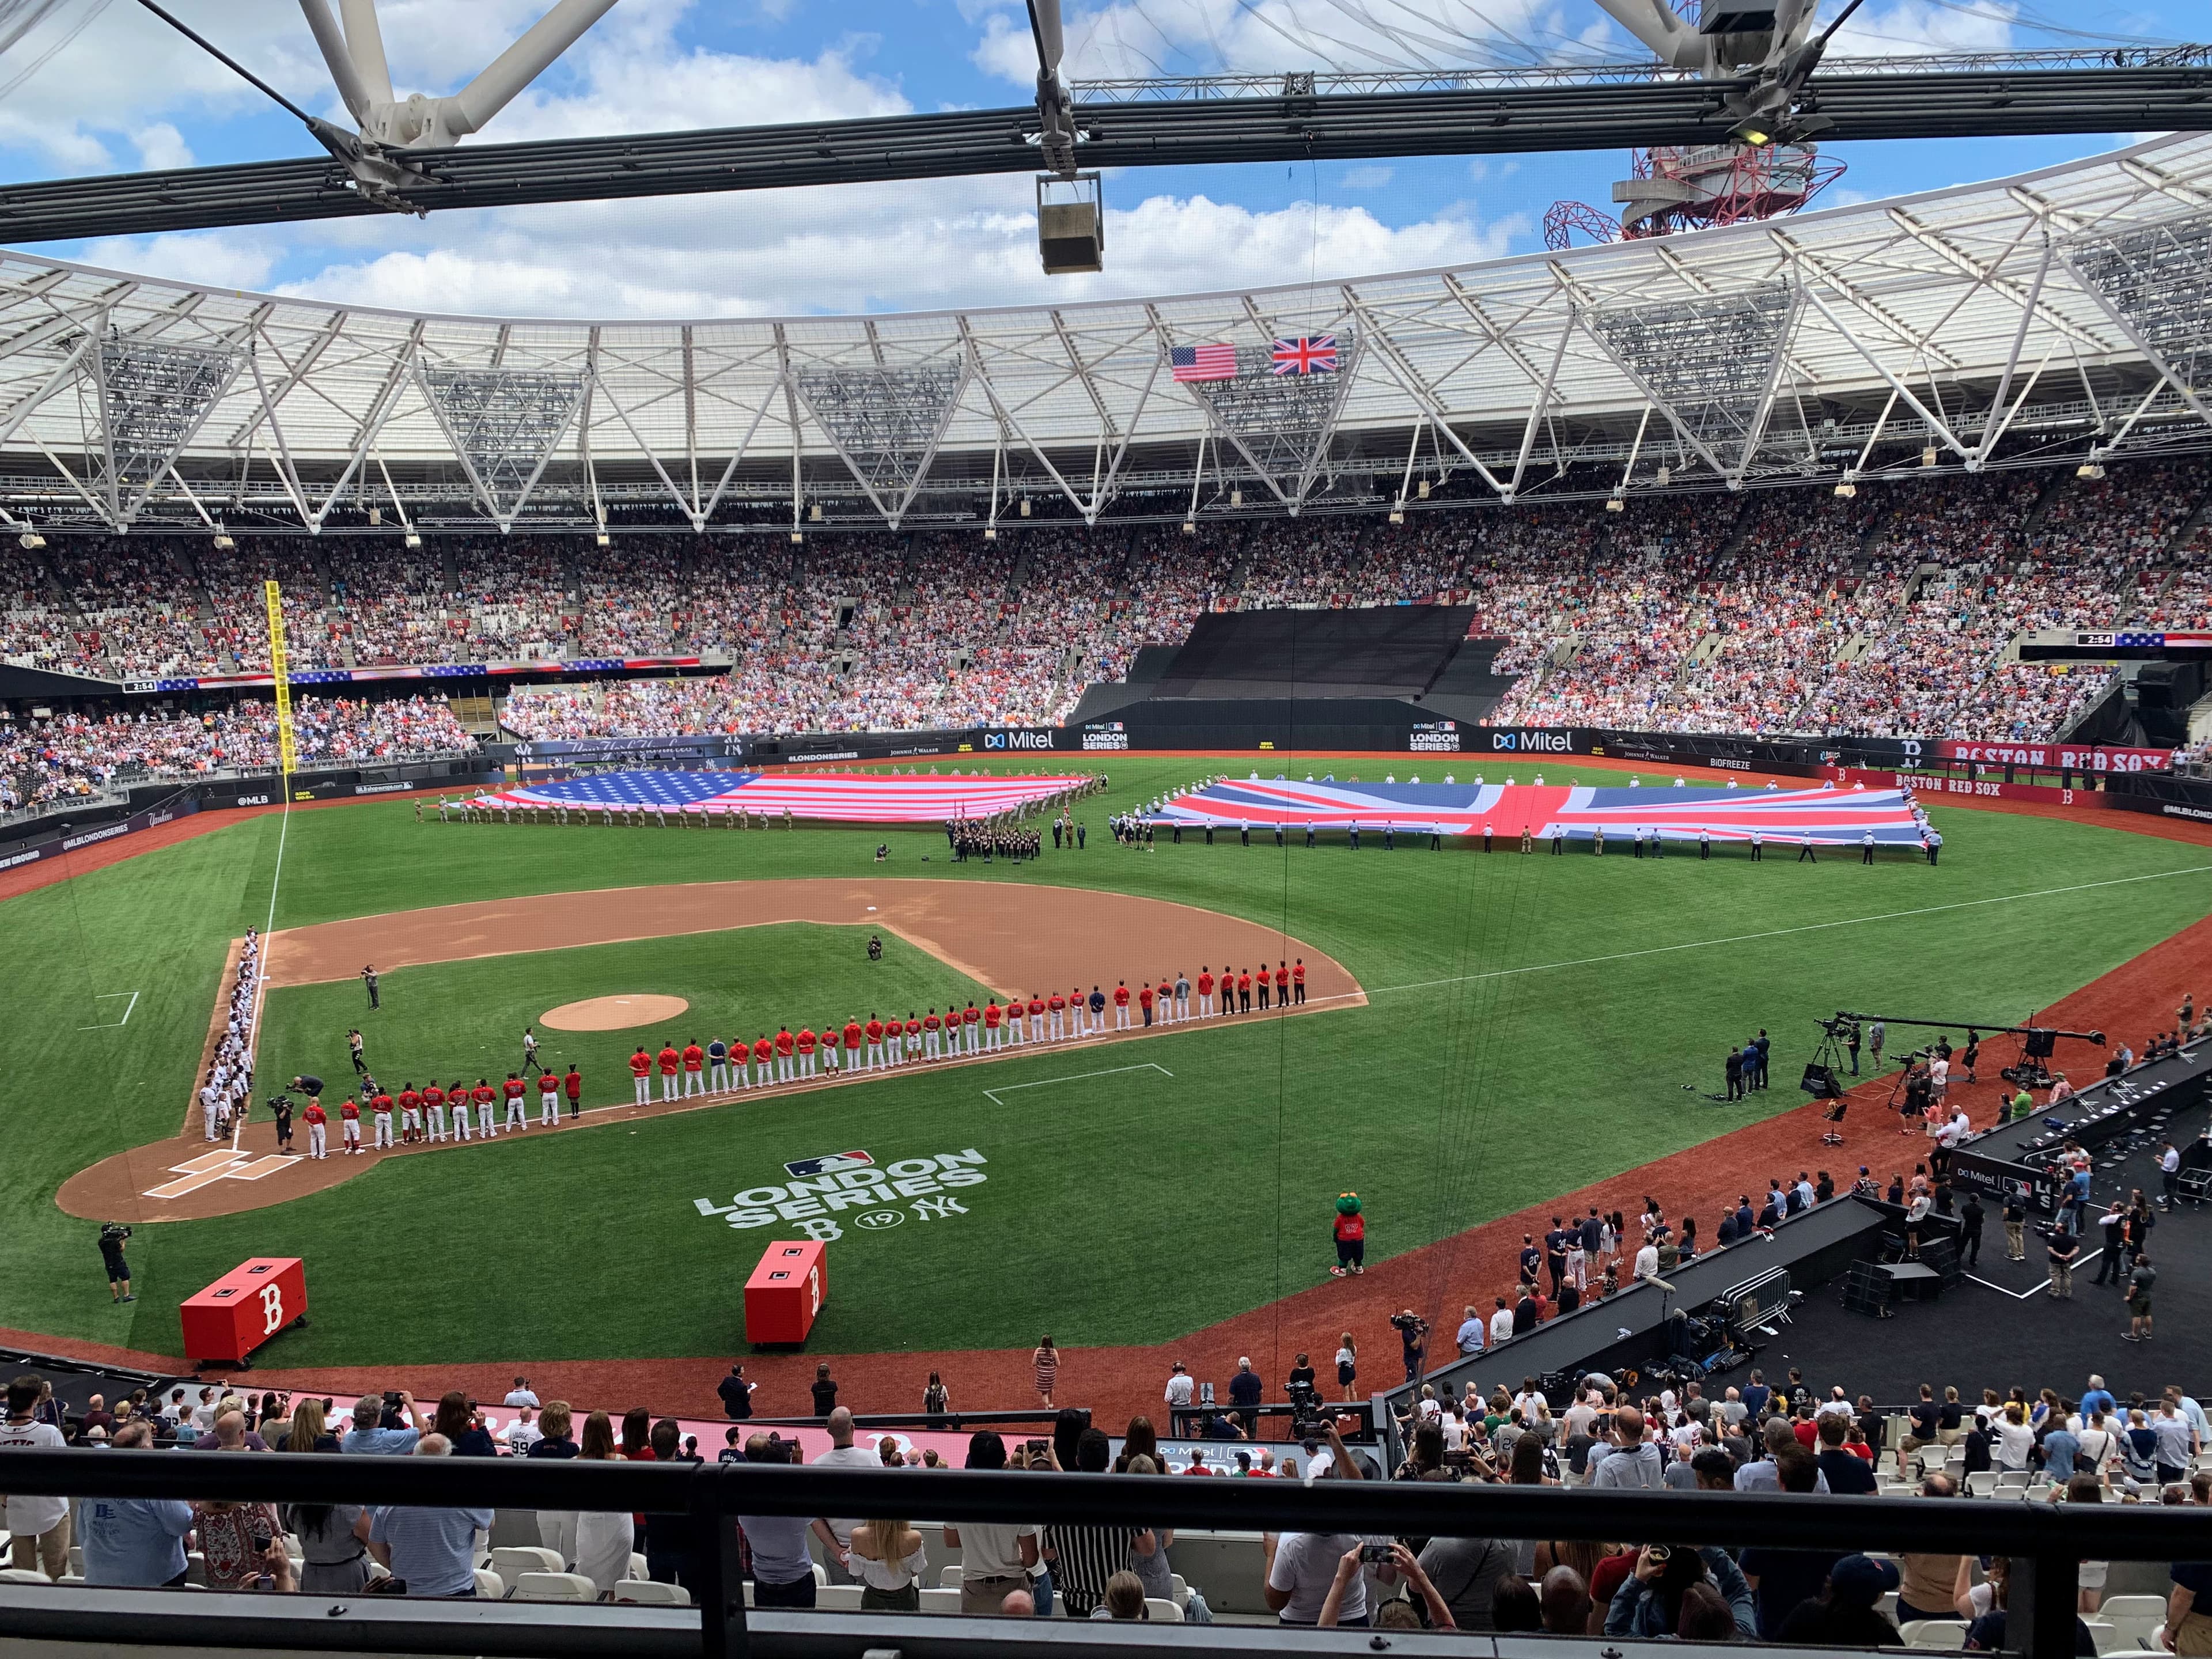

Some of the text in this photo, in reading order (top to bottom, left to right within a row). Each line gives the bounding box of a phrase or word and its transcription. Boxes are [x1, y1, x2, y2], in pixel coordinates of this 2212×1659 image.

[2088, 635, 2111, 644] 2:54
[1009, 730, 1054, 748] Mitel
[1083, 733, 1127, 741] LONDON
[1410, 733, 1459, 742] LONDON
[1520, 732, 1573, 751] Mitel
[1410, 743, 1450, 751] SERIES
[789, 751, 858, 762] #LONDONSERIES
[1624, 751, 1669, 761] JOHNNIE WALKER
[1896, 774, 2001, 796] BOSTON RED SOX
[238, 795, 268, 805] @MLB
[147, 809, 173, 827] Yankees
[63, 824, 128, 850] @MLBLONDONSERIES
[693, 1149, 988, 1216] LONDON
[1970, 1170, 1995, 1185] Mitel
[725, 1168, 987, 1229] SERIES
[259, 1283, 283, 1335] B
[513, 1431, 528, 1440] JUDGE
[512, 1441, 529, 1455] 99
[1179, 1448, 1214, 1456] Mel
[722, 1455, 737, 1463] JUDGE
